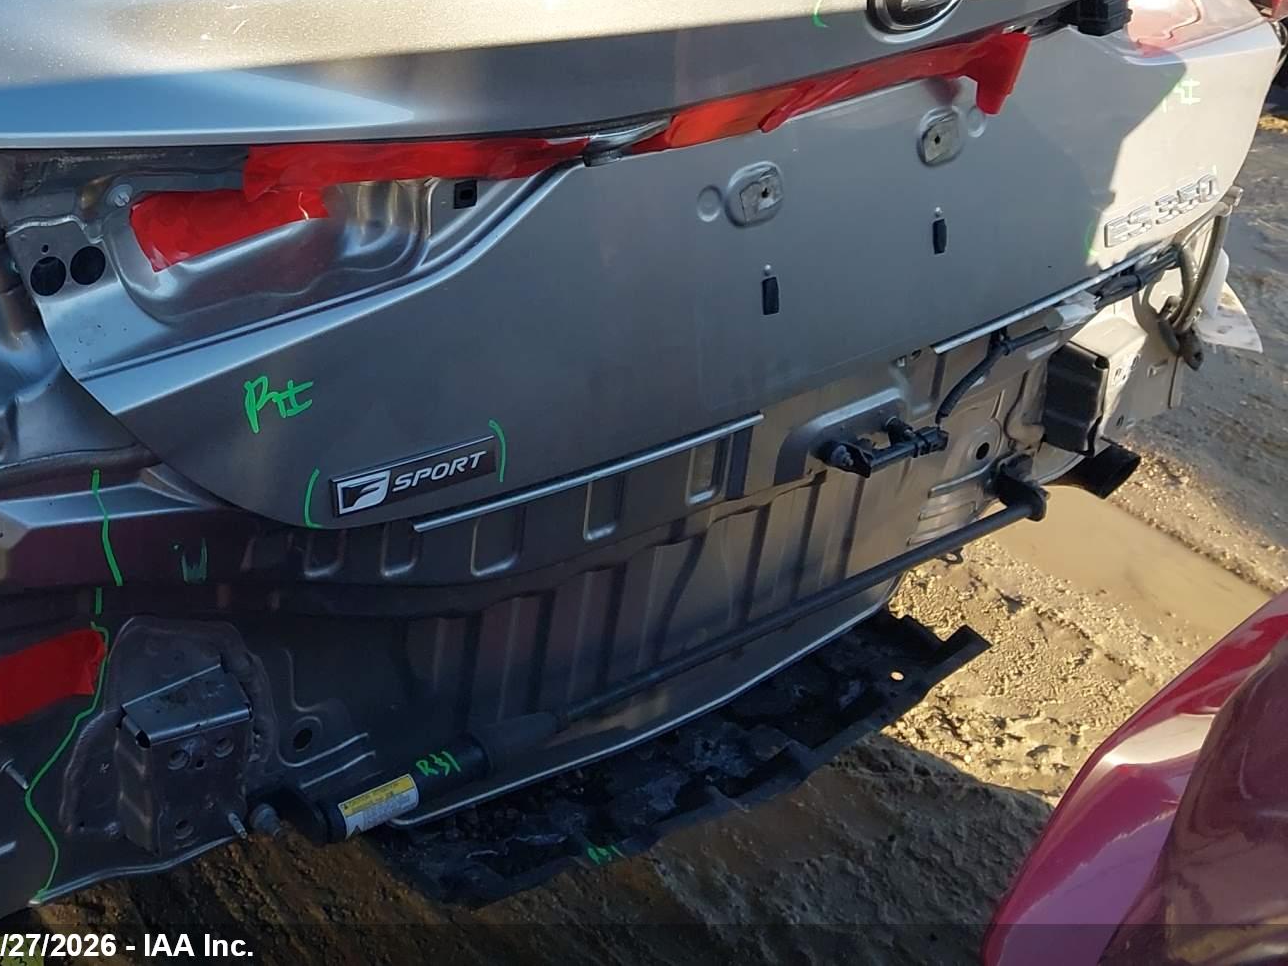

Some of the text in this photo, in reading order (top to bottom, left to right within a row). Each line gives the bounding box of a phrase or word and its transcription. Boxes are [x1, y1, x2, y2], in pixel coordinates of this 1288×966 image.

[1103, 173, 1220, 248] ES 350
[391, 449, 488, 493] SPORT
